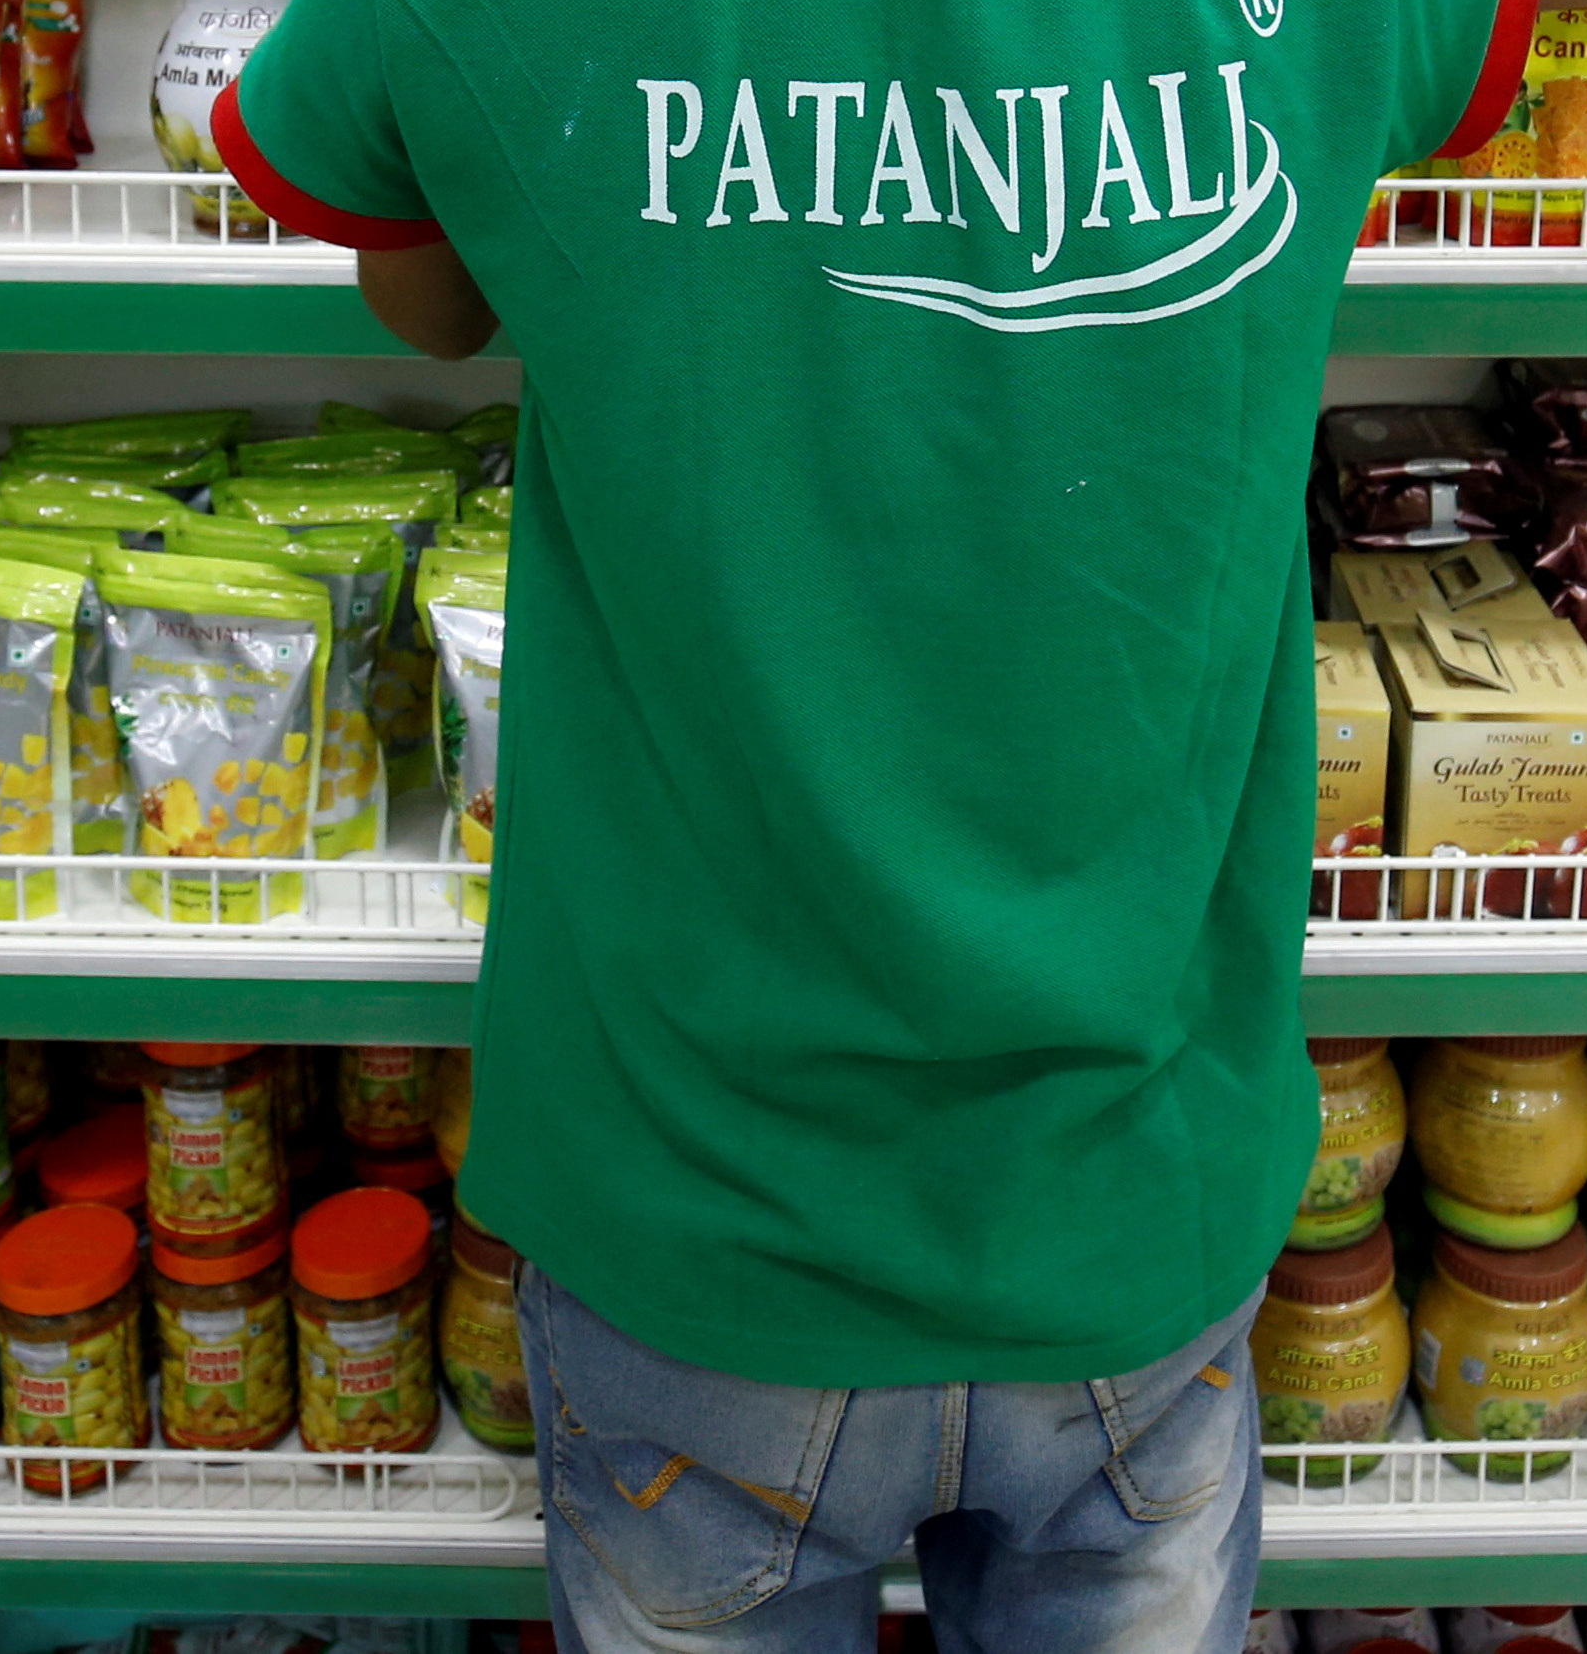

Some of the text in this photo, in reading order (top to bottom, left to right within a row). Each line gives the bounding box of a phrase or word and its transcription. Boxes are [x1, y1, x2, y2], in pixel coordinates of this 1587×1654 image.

[159, 64, 199, 86] Amla
[636, 60, 1255, 272] PATANJALI
[1486, 734, 1551, 746] PATANJALI
[1432, 757, 1504, 783] Gulab
[1454, 784, 1572, 808] Tasty Treats
[171, 1129, 223, 1149] Lemon
[172, 1147, 222, 1167] Pickle
[187, 1348, 239, 1366] Lemon
[339, 1357, 395, 1377] Lemon
[185, 1364, 240, 1385] Pickle
[340, 1375, 393, 1394] Pickle
[1268, 1366, 1386, 1392] Amla Candy
[18, 1378, 66, 1397] Lemon
[18, 1396, 66, 1416] Pickle
